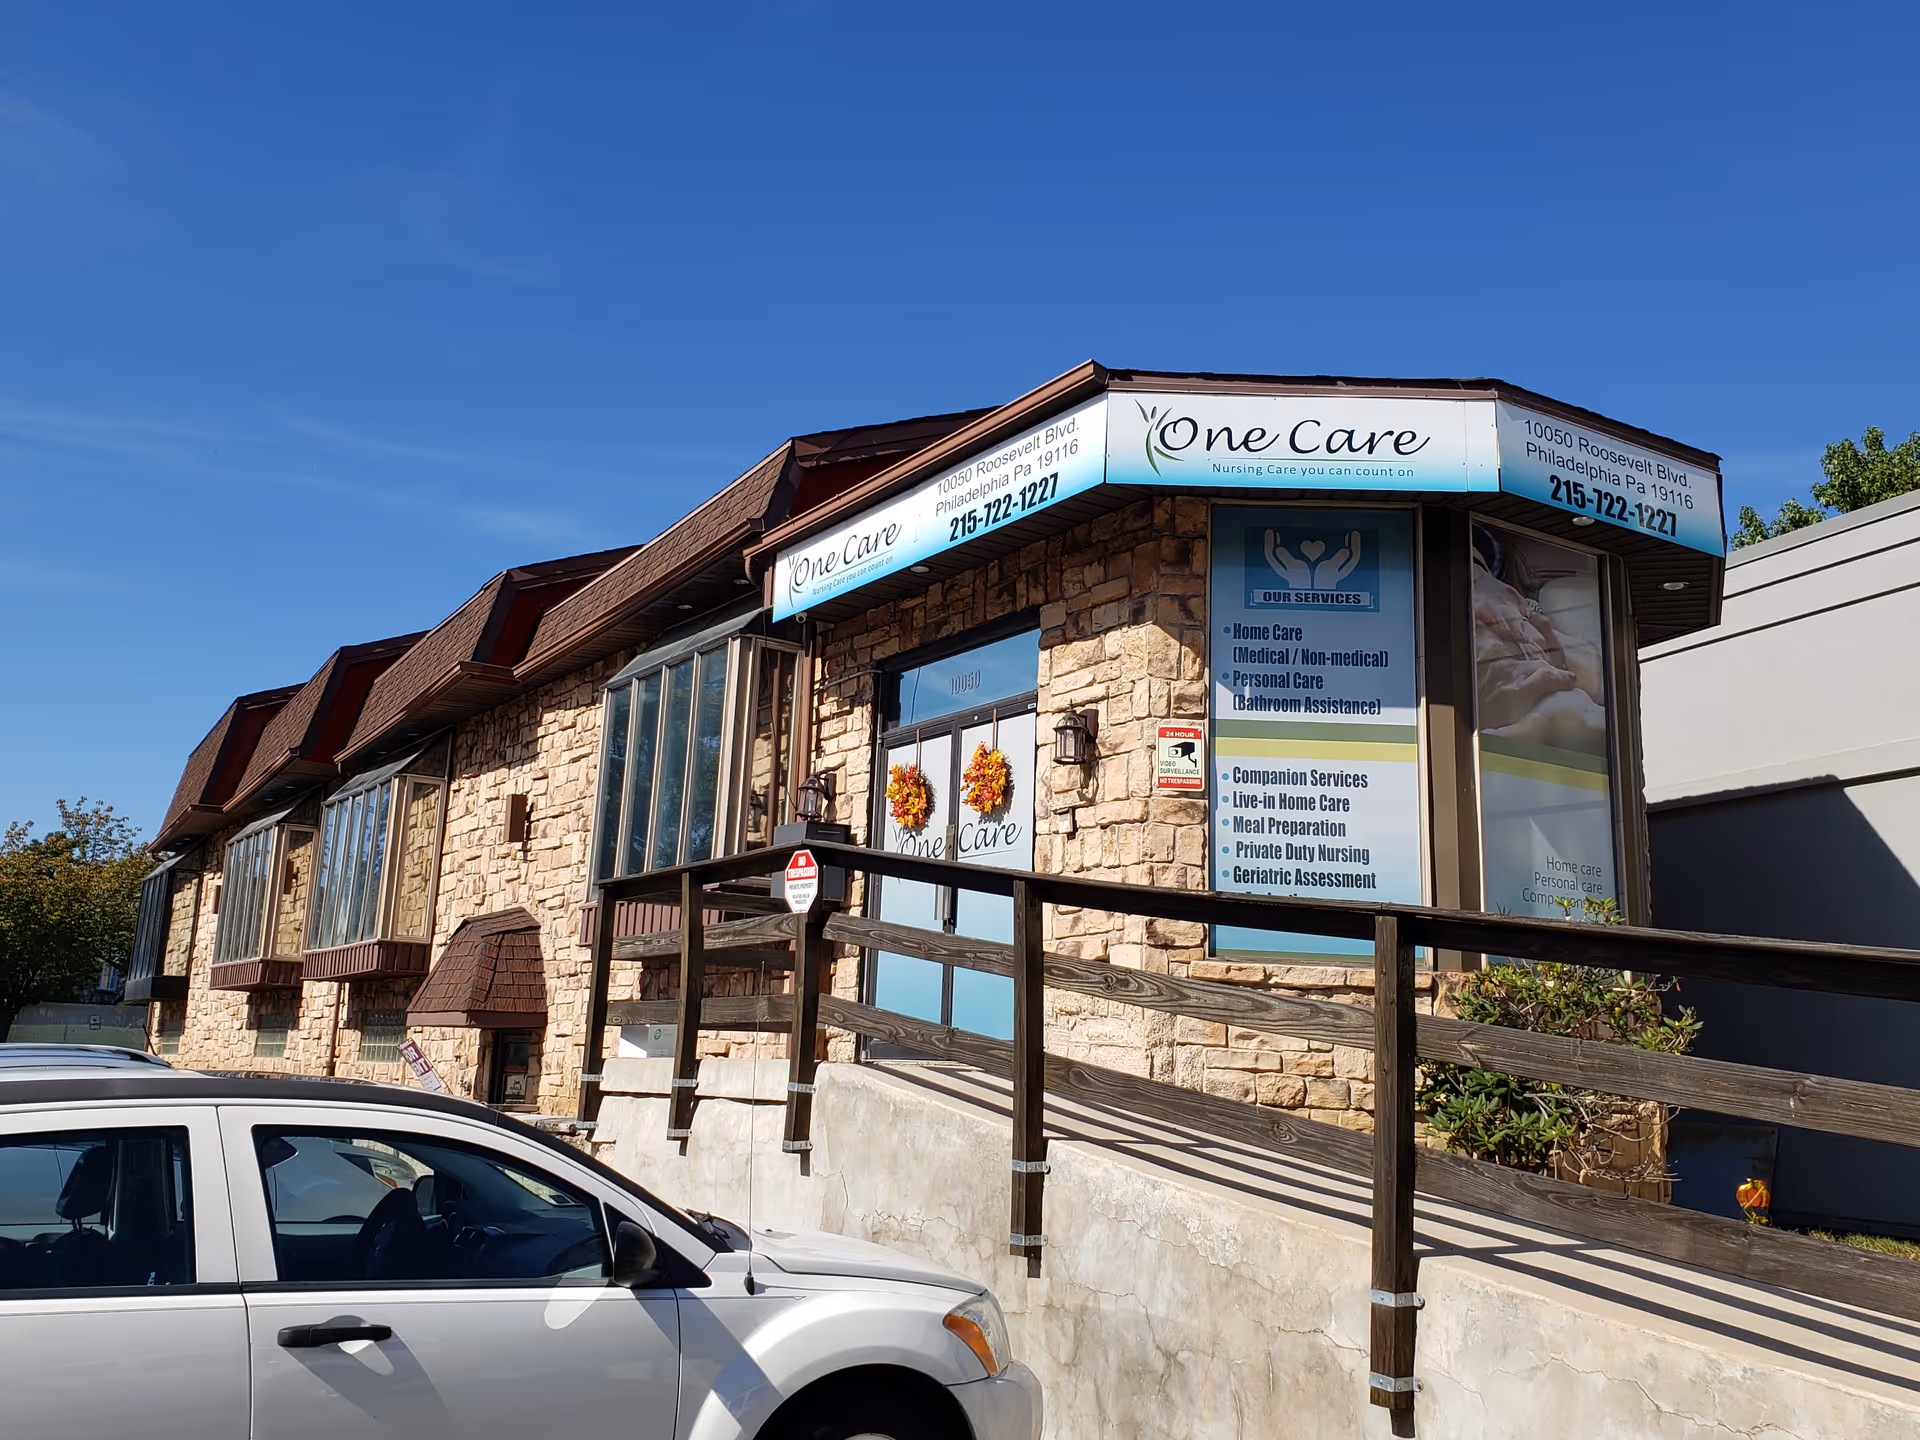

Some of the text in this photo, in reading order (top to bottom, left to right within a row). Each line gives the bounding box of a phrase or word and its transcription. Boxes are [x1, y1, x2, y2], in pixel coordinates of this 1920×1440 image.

[1159, 416, 1430, 455] One Care
[936, 418, 1080, 496] 10050 Roosevelt Blvd.
[1524, 419, 1692, 489] 10050 Roosevelt Blvd.
[935, 439, 1079, 518] Philadelphia Pa 19116
[1212, 463, 1414, 477] Nursing Care you can count on
[1526, 441, 1694, 510] Philadelphia Pa 19116
[949, 472, 1059, 542] 215-722-1227
[1550, 474, 1676, 538] 215-722-1227
[795, 523, 903, 587] One Care
[833, 576, 845, 587] Care
[846, 572, 857, 584] you
[857, 567, 868, 578] can
[868, 559, 885, 573] count
[1262, 591, 1361, 604] OUR SERVICES
[1233, 623, 1303, 642] Home Care
[1233, 646, 1389, 668] (Medical / Non-medical)
[950, 670, 981, 696] 10050
[1233, 670, 1324, 690] Personal Care
[1233, 694, 1381, 716] (Bathroom Assistance)
[1233, 766, 1368, 788] Companion Services
[1233, 791, 1350, 812] Live-in Home Care
[958, 822, 1023, 852] Care
[1233, 815, 1346, 838] Meal Preparation
[1236, 840, 1370, 865] Private Duty Nursing
[1233, 865, 1377, 889] Geriatric Assessment
[1546, 856, 1602, 877] Home care
[1534, 871, 1603, 895] Personal care
